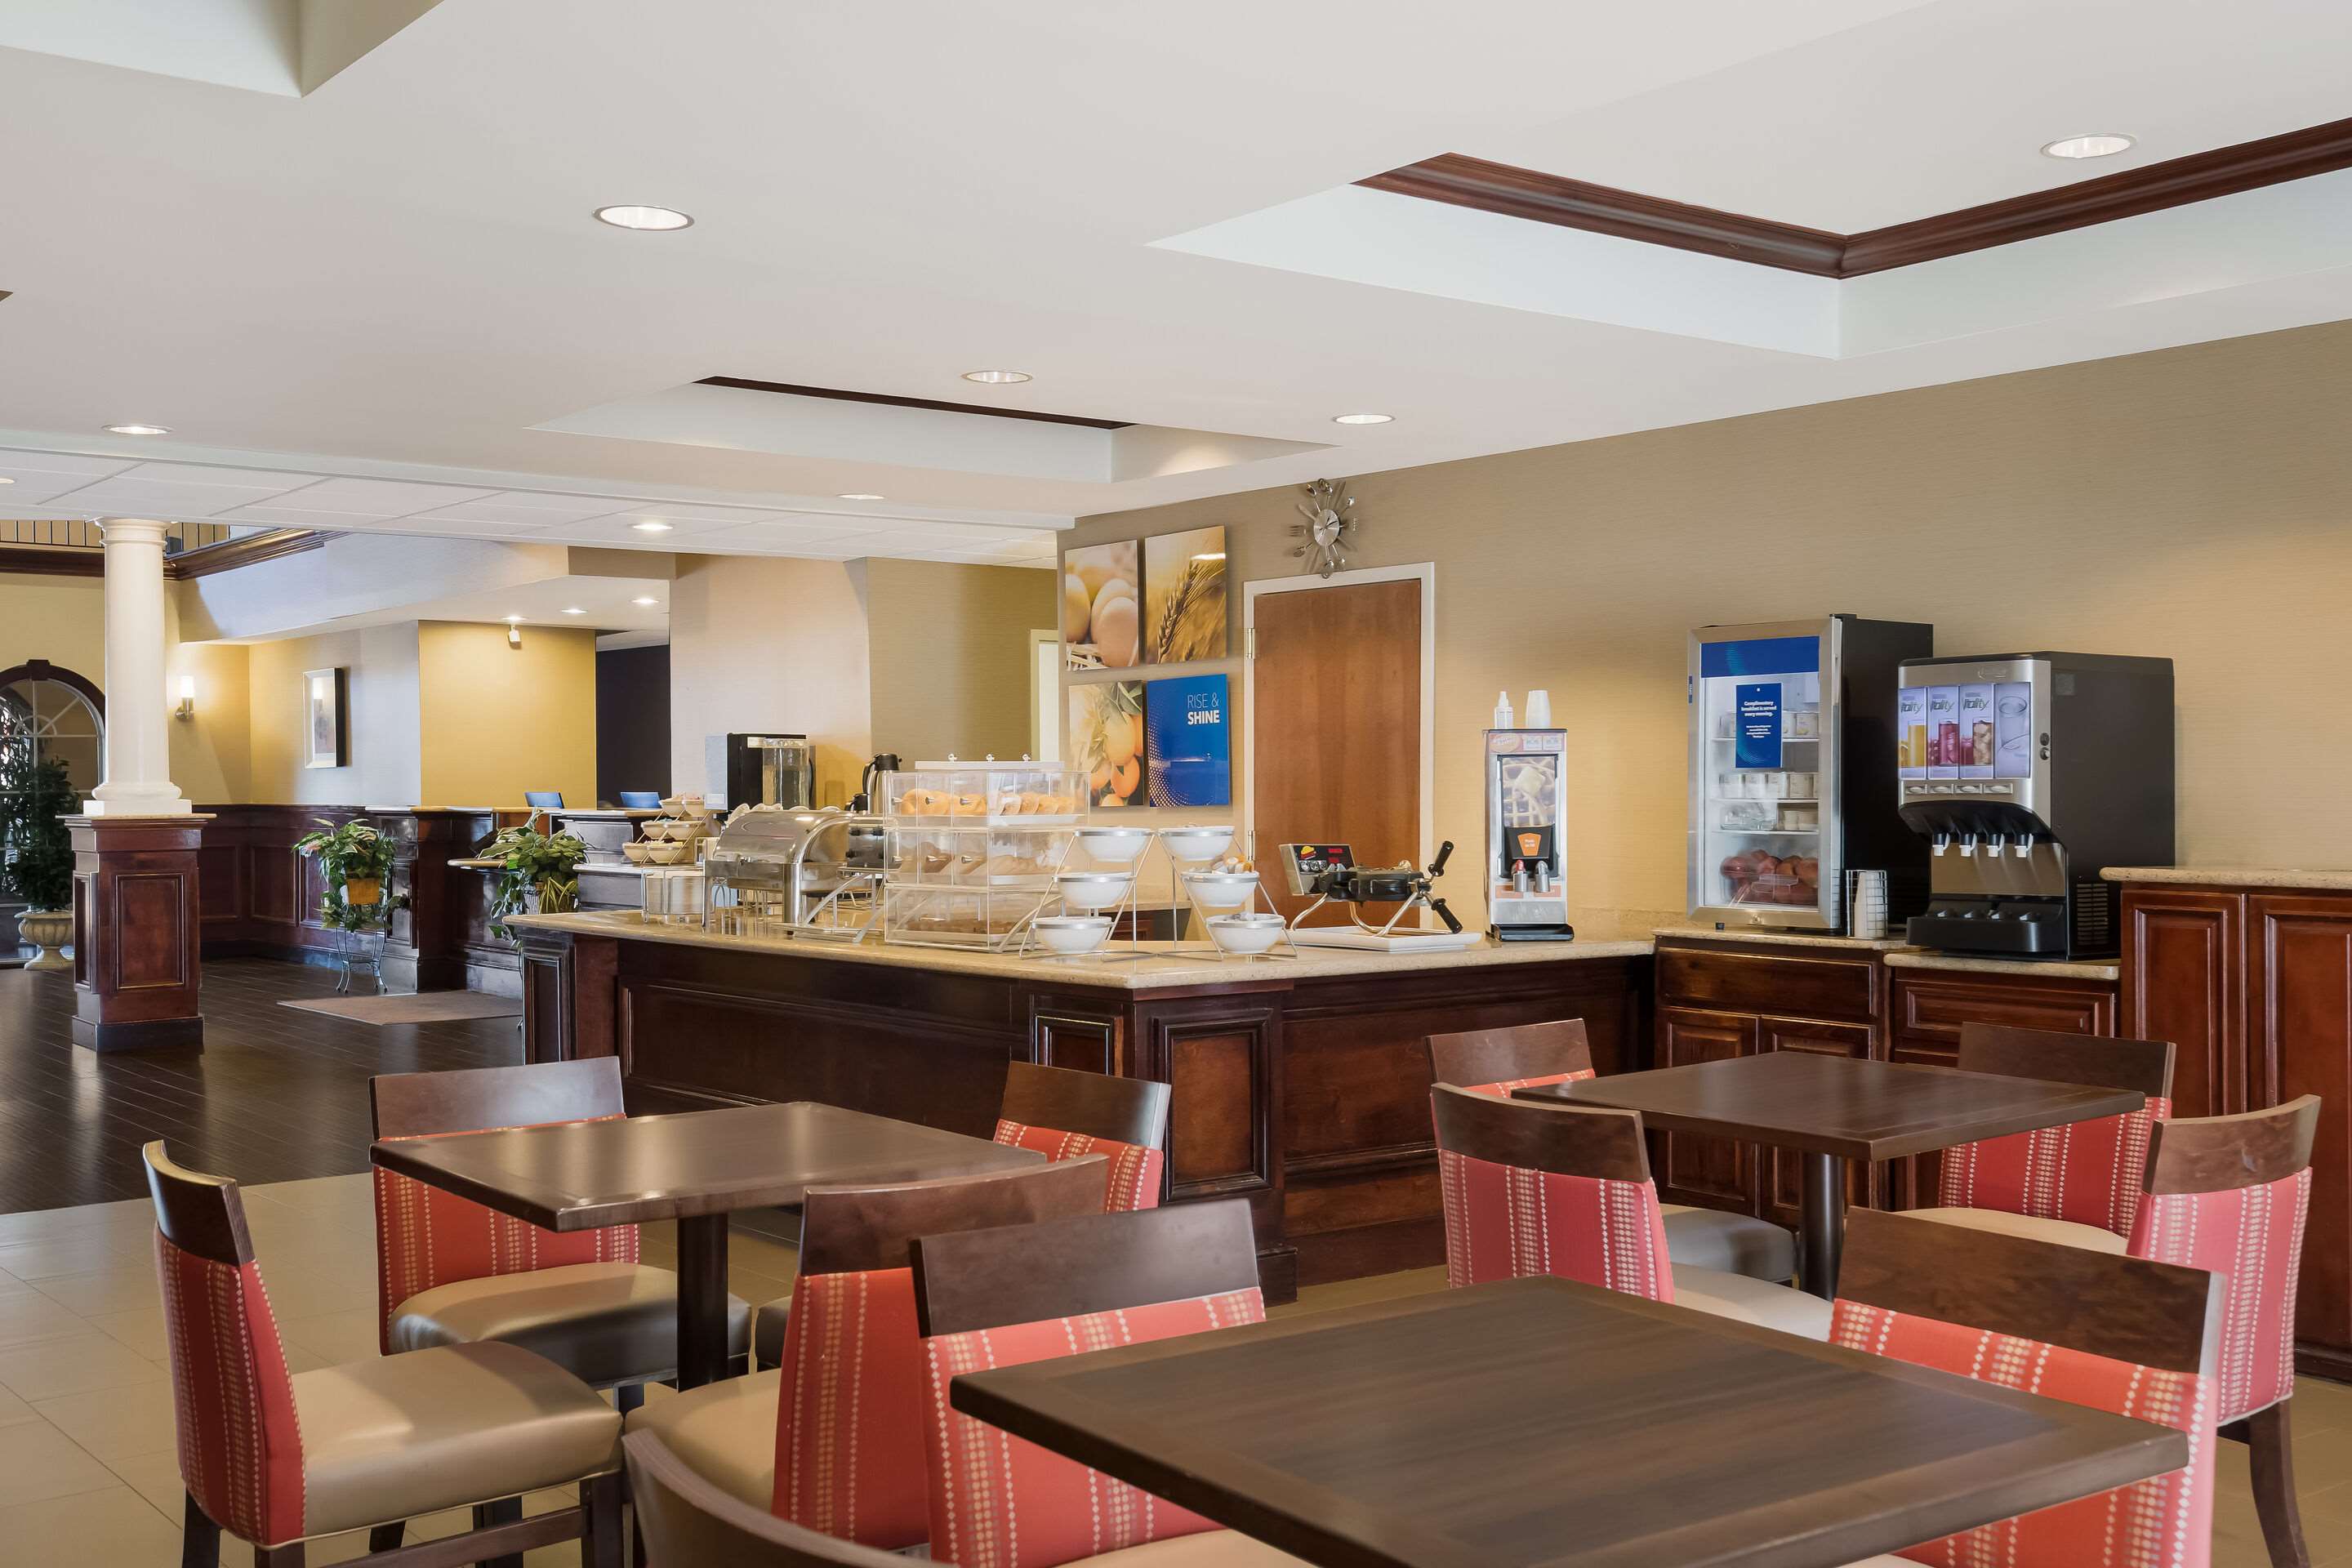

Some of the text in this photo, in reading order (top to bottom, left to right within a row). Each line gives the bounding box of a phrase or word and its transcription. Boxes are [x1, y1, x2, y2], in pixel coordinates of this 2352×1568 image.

[1187, 692, 1219, 709] RISE &
[1187, 710, 1220, 725] SHINE
